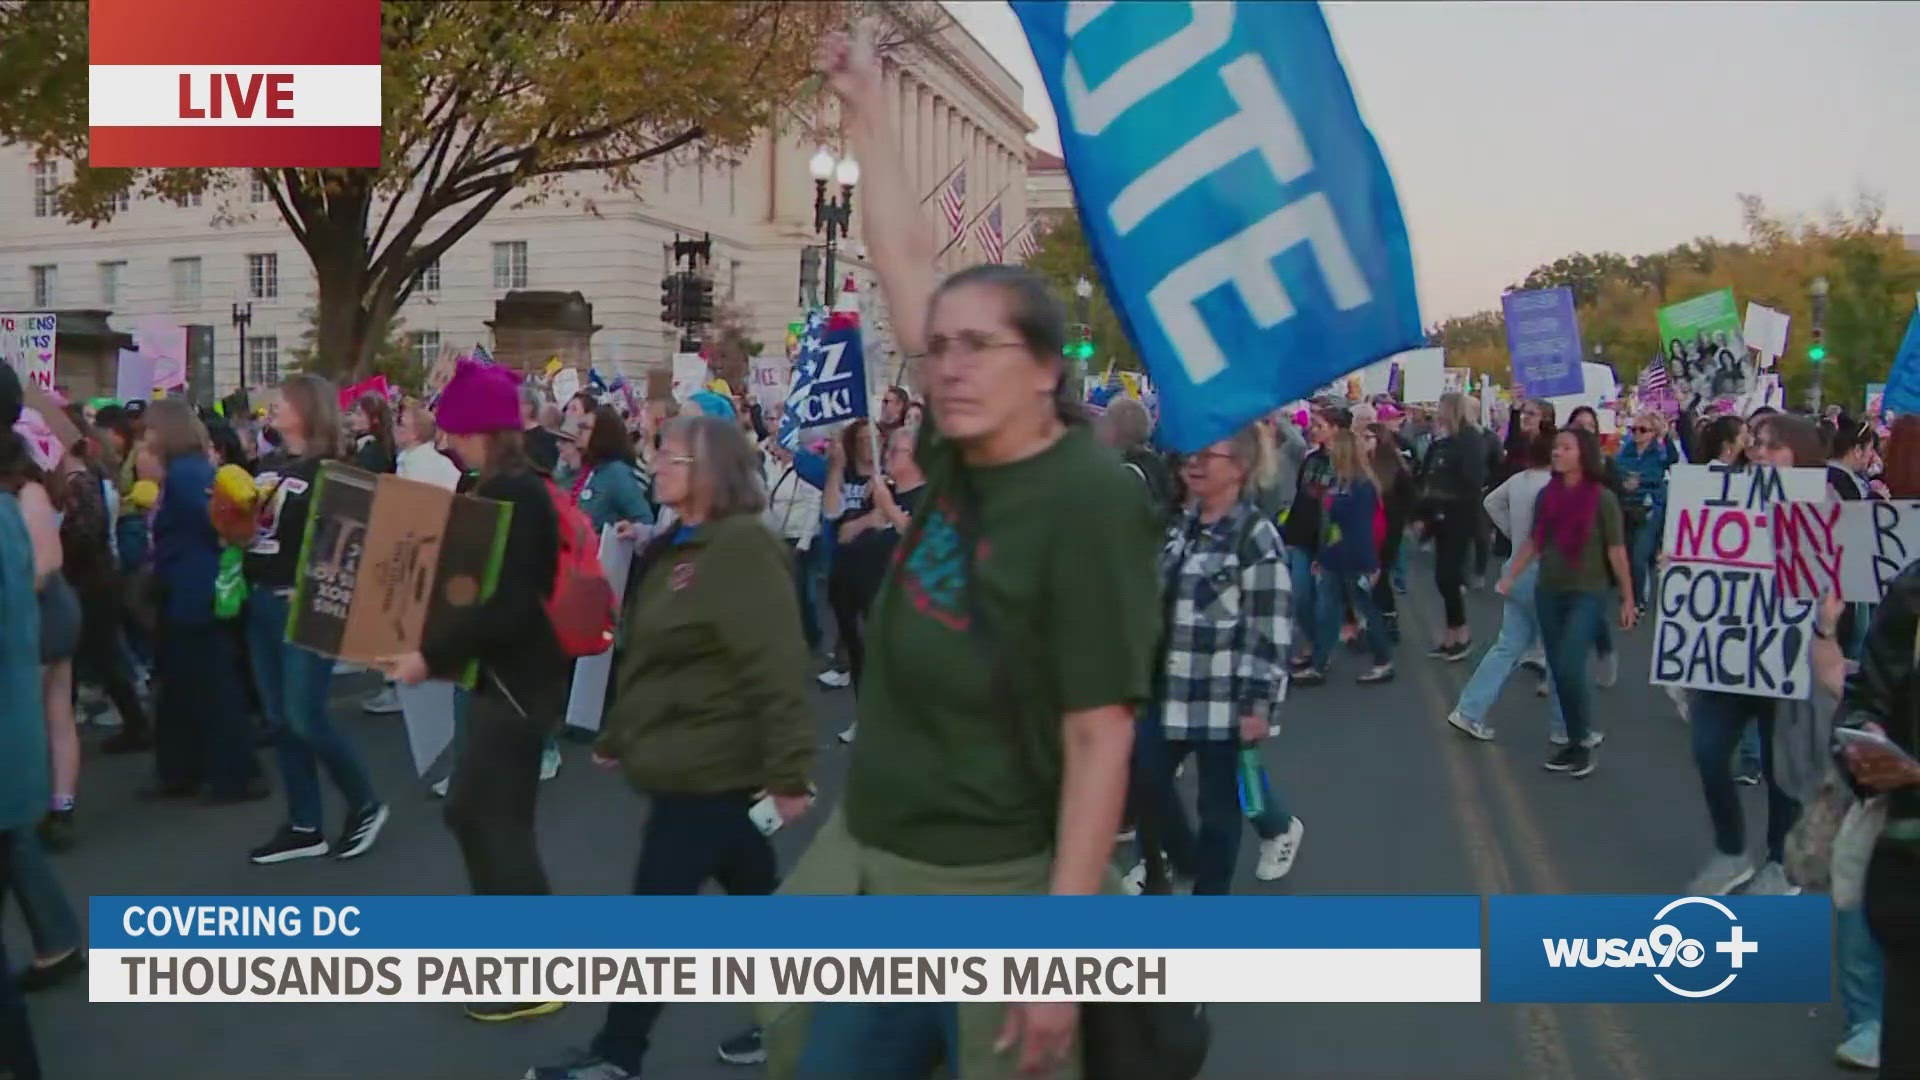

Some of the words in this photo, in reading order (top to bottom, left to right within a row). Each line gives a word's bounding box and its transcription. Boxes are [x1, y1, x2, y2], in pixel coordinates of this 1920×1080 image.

[1704, 464, 1786, 512] I'M
[1675, 508, 1769, 560] NO
[1774, 502, 1843, 556] MY
[1775, 546, 1845, 600] MY
[1656, 621, 1803, 695] BACK!
